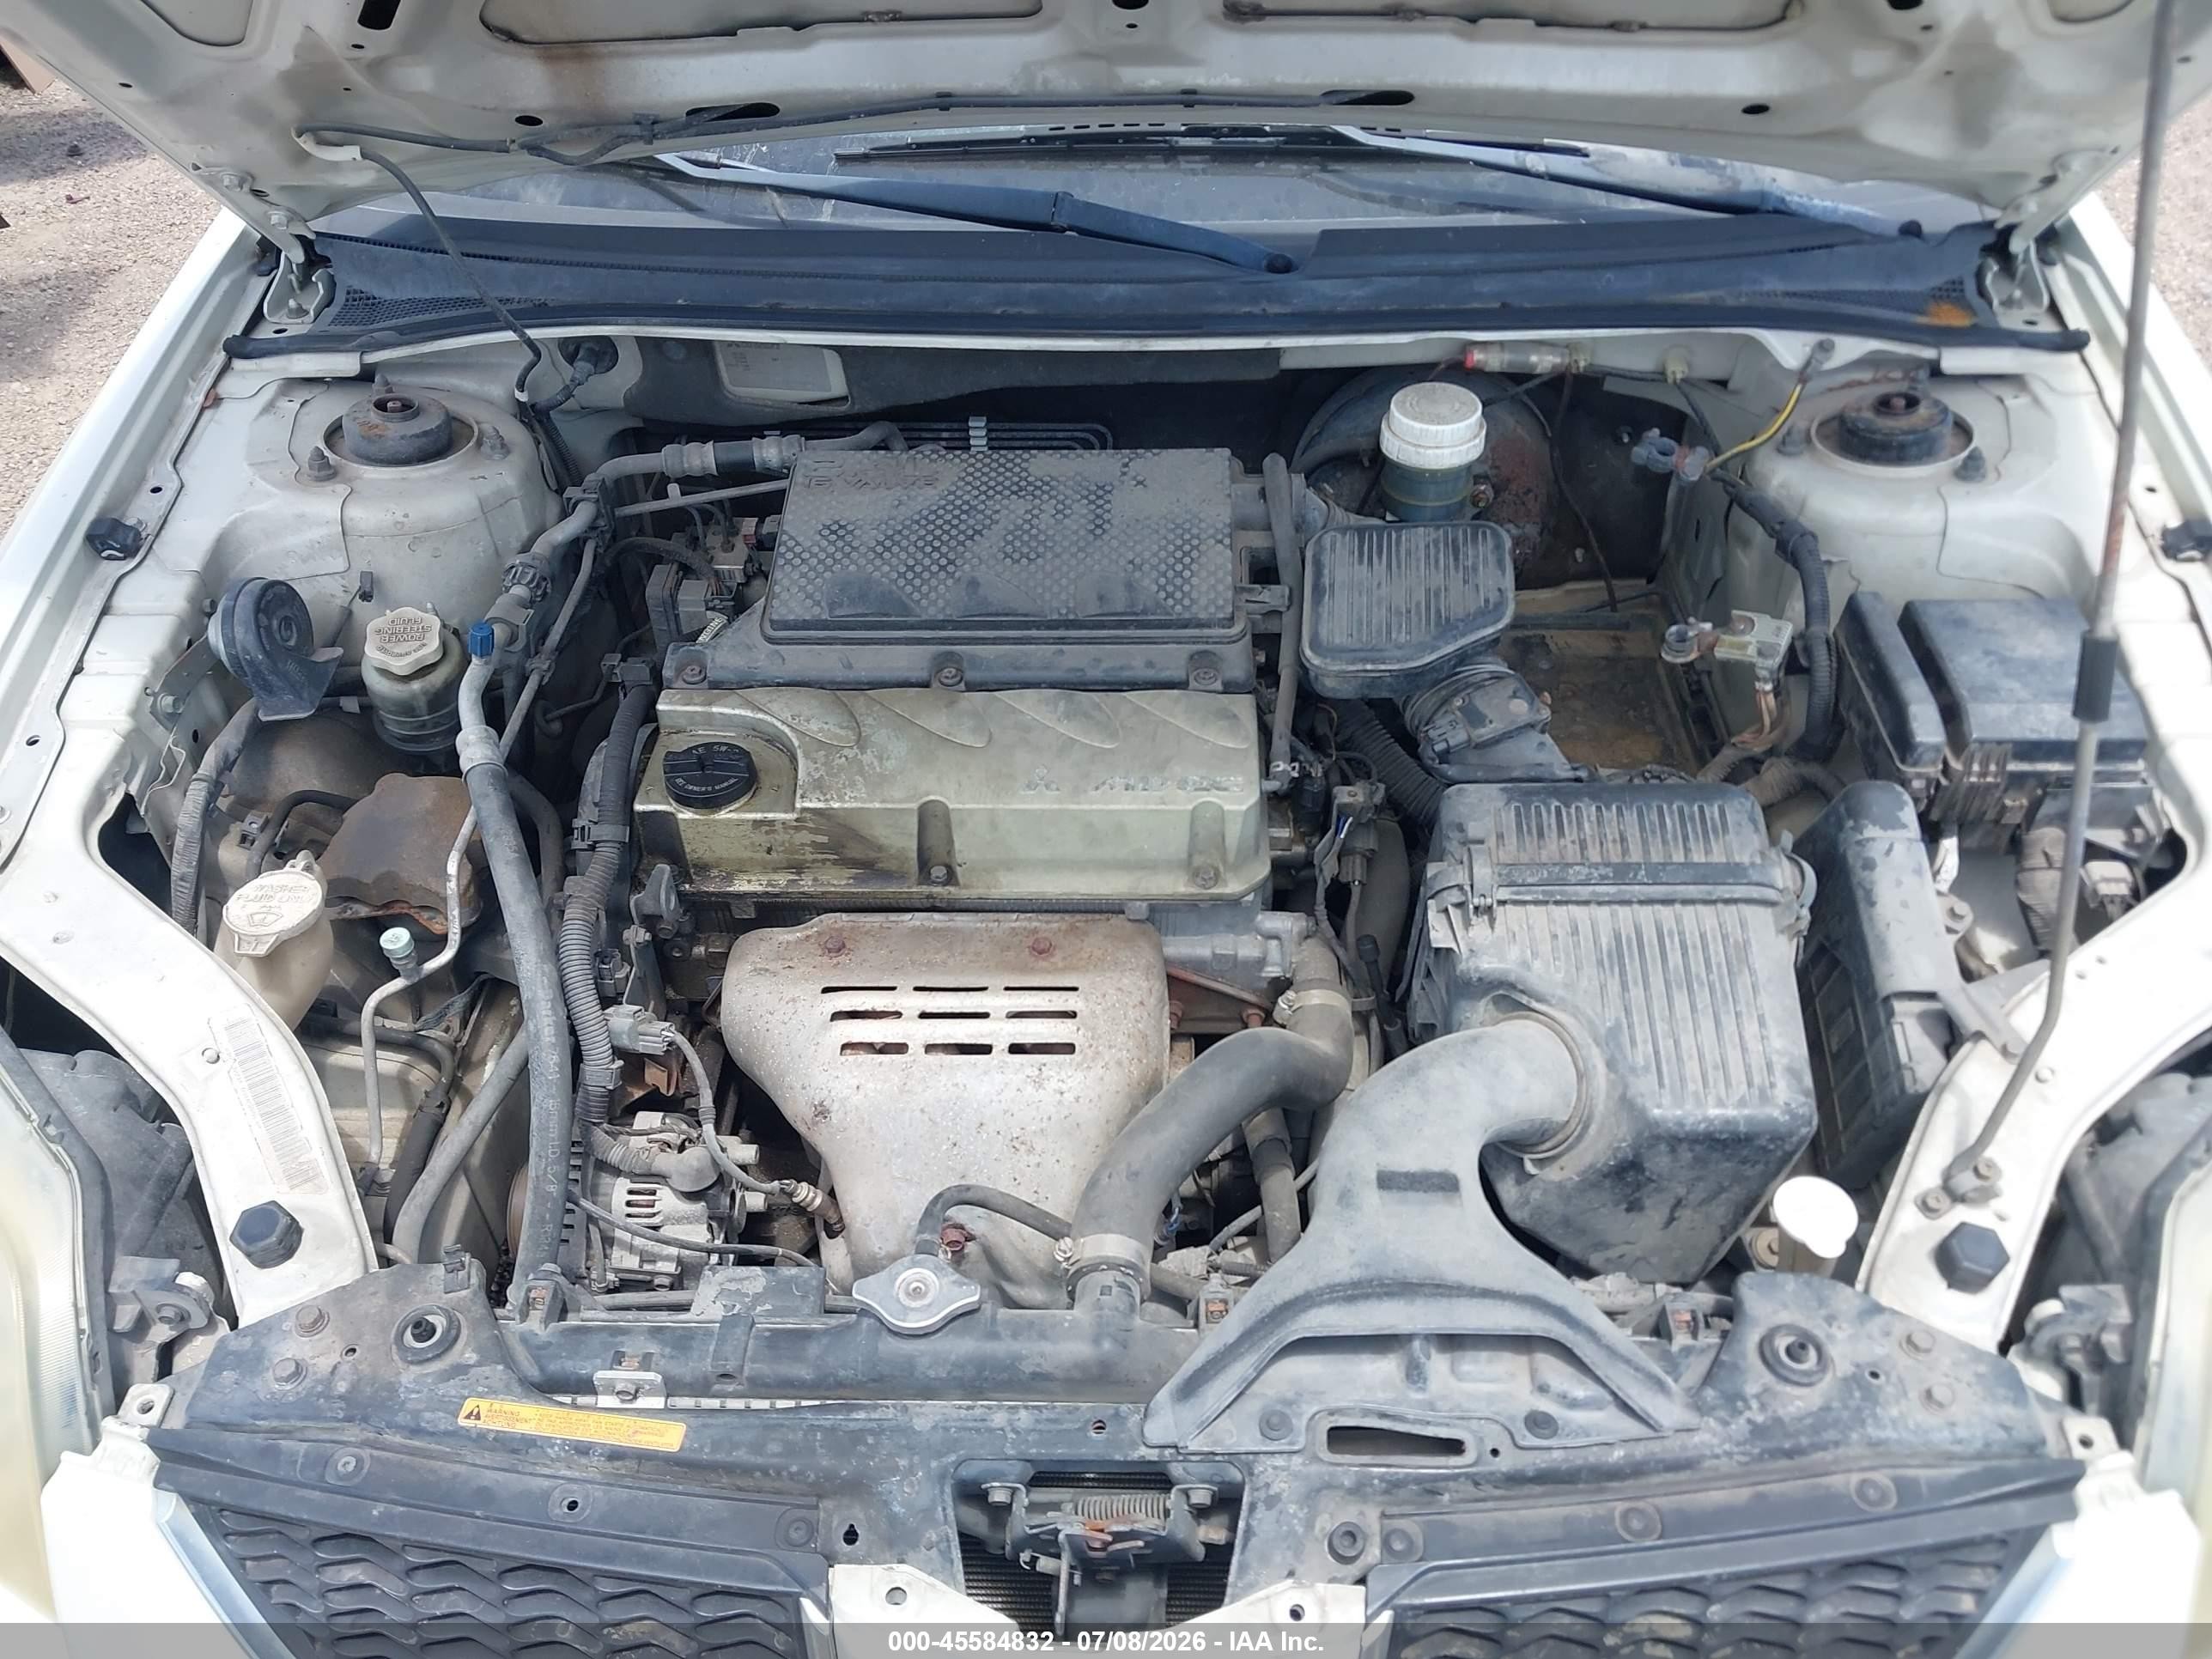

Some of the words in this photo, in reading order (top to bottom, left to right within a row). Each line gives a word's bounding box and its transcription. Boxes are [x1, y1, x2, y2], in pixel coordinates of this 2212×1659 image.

[388, 617, 422, 626] FLUID
[374, 625, 432, 635] STEERING
[380, 634, 425, 643] POWER
[236, 893, 275, 904] FLUID
